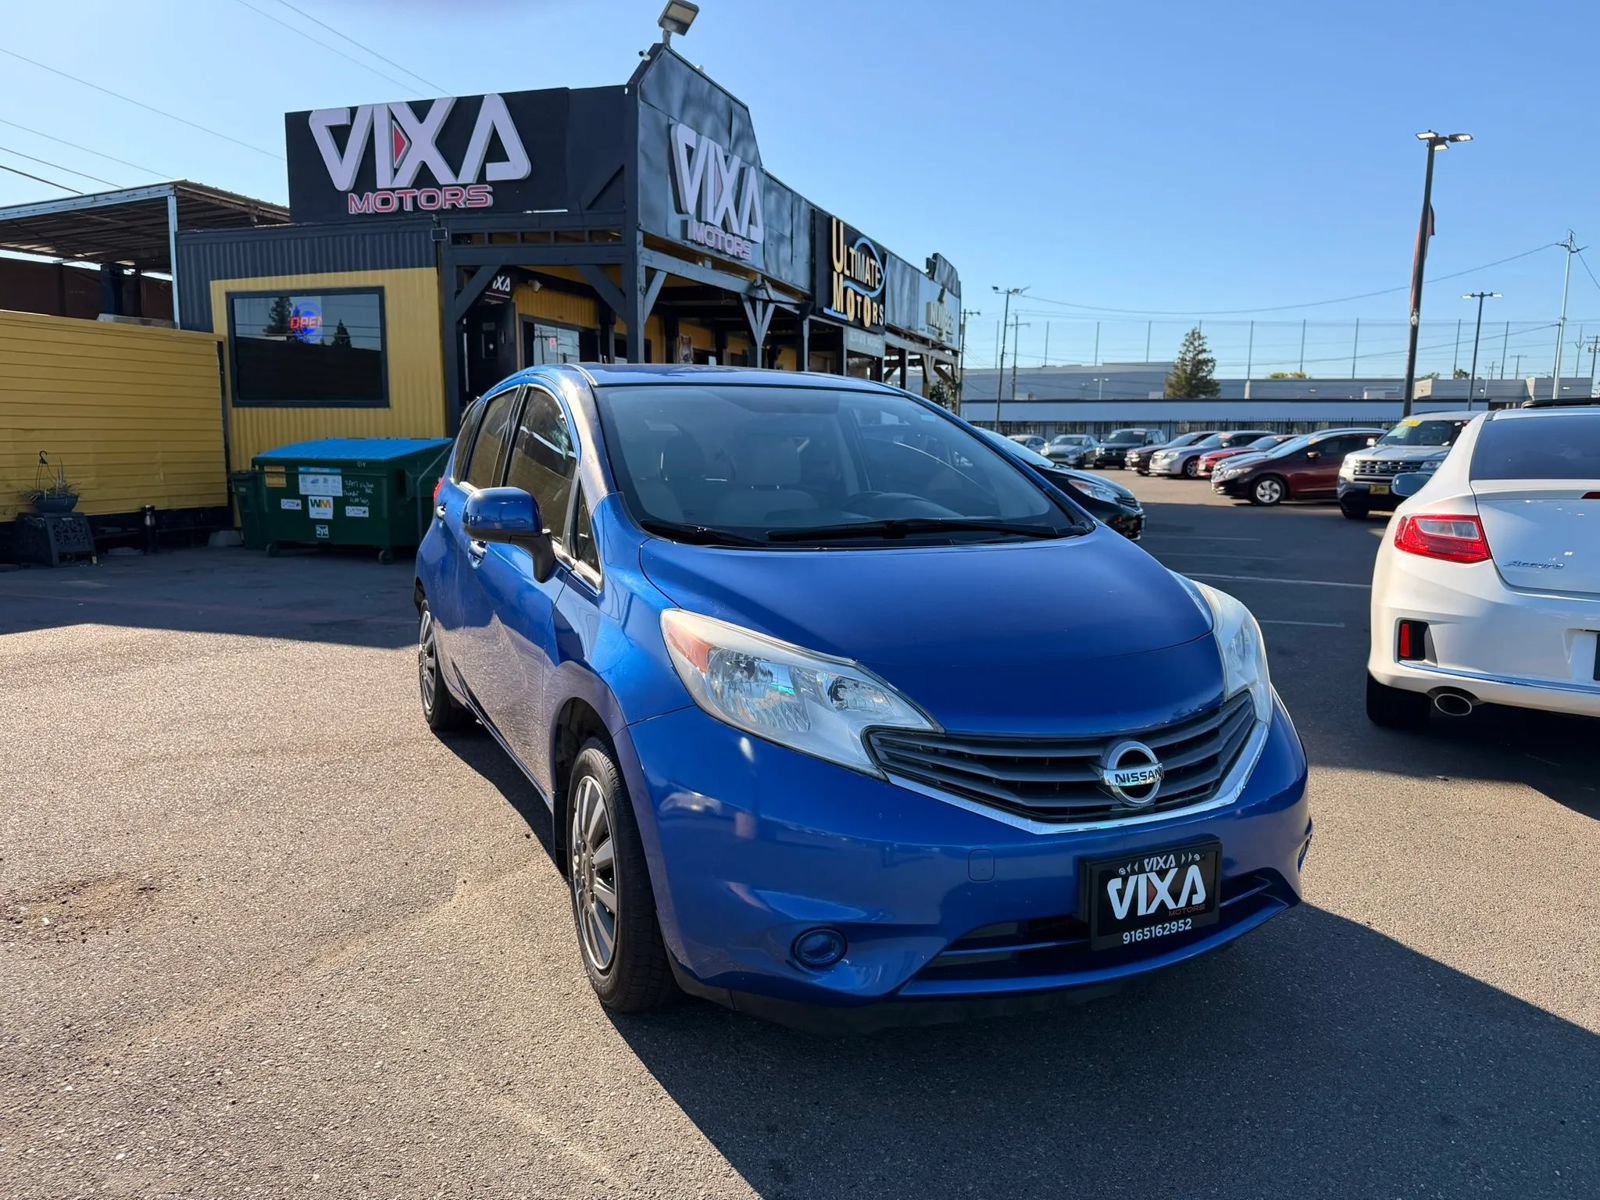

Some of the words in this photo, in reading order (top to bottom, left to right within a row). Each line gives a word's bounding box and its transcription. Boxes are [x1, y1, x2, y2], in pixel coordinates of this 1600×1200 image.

[309, 93, 531, 191] VIXA
[671, 122, 764, 243] VIXA
[348, 185, 493, 214] MOTORS
[689, 220, 752, 260] MOTORS
[491, 275, 511, 292] IXA
[832, 271, 884, 328] MOTORS
[310, 499, 331, 509] WM
[1114, 766, 1164, 784] NISSAN
[1144, 854, 1176, 872] VIXA
[1107, 864, 1206, 920] VIXA
[1168, 903, 1206, 917] MOTORS
[1122, 918, 1192, 945] 9165162952
